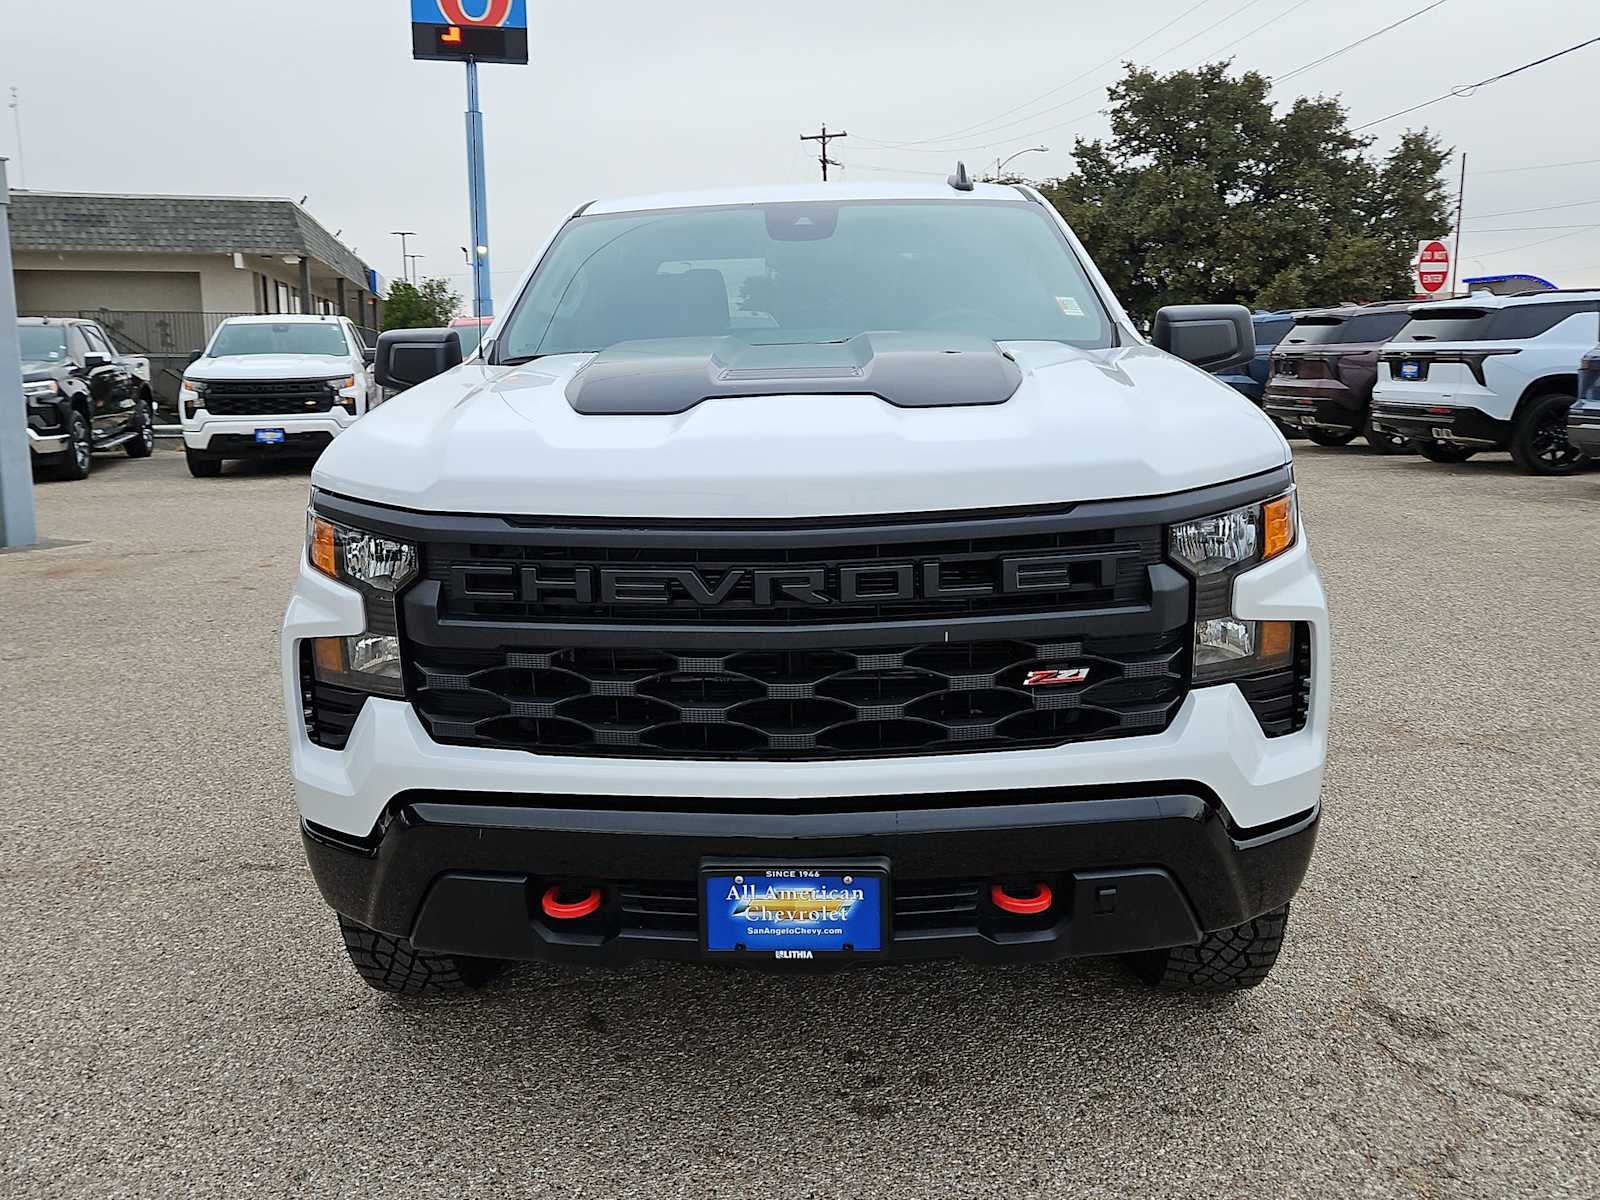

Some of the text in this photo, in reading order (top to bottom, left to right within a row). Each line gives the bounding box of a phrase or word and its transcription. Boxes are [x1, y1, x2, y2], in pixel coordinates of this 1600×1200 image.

[451, 548, 1142, 605] CHEVROLET
[765, 870, 820, 878] SINCE 1946
[726, 885, 864, 901] All American
[745, 905, 849, 922] Chevrolet
[783, 950, 813, 959] LITHIA
